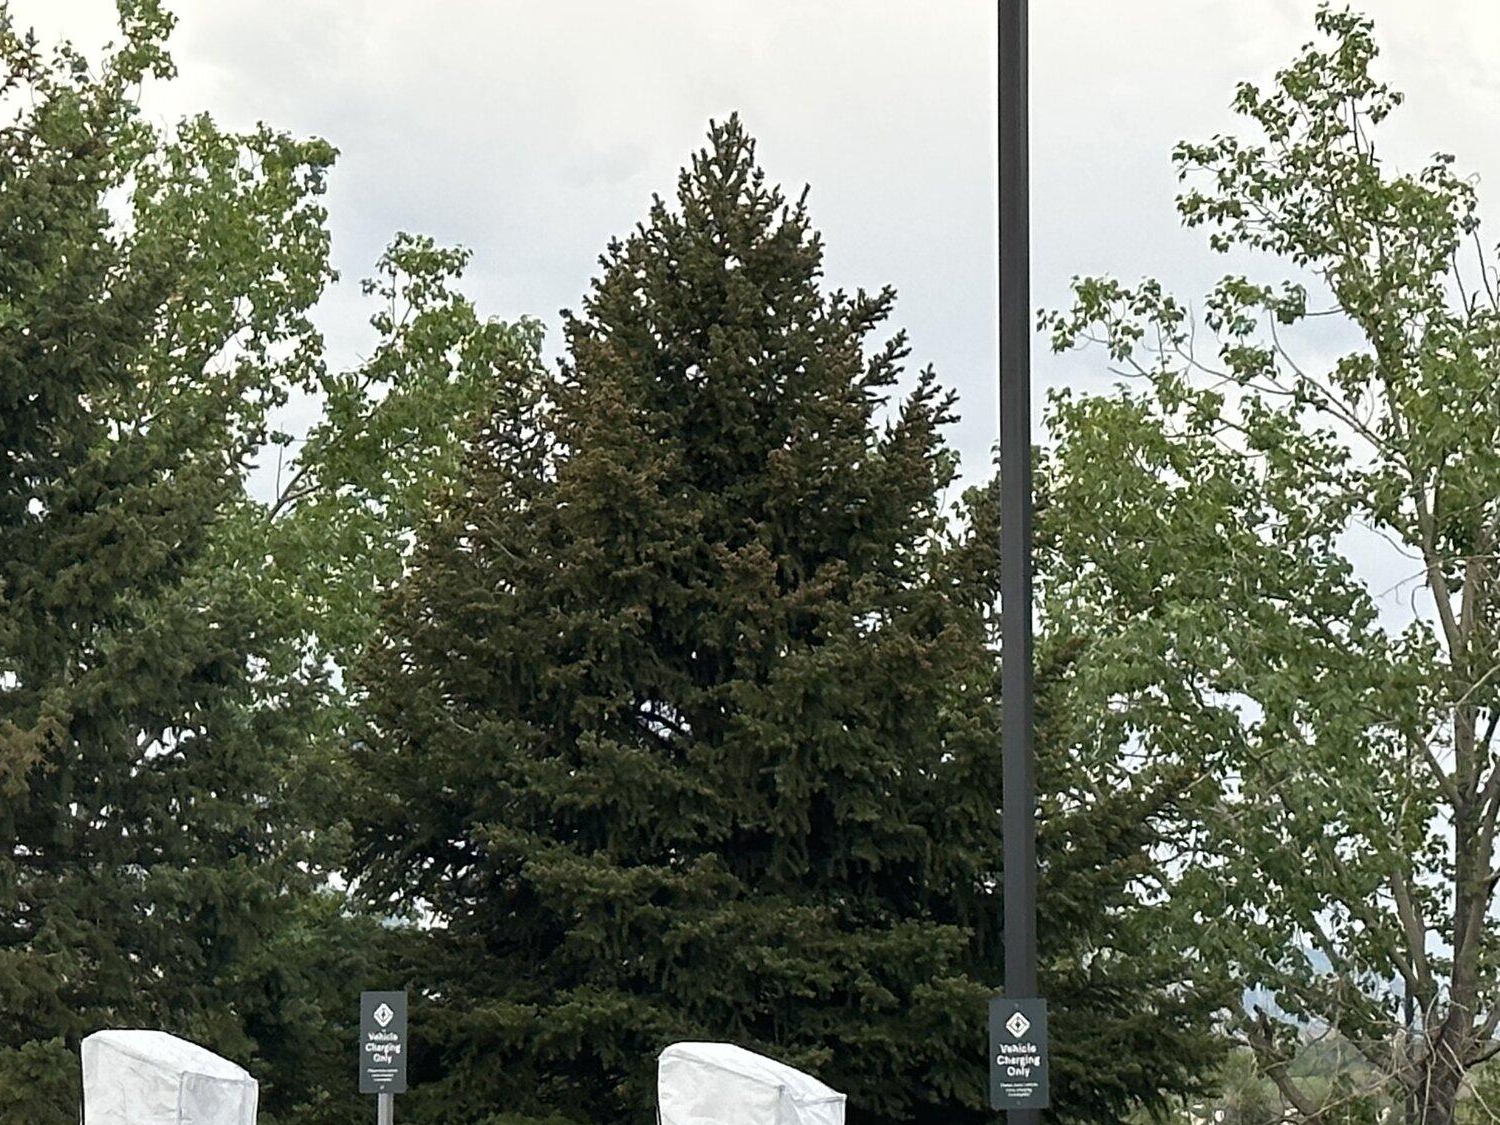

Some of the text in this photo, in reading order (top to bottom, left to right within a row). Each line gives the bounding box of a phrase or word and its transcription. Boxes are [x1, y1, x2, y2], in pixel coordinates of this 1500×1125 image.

[367, 1031, 399, 1041] Vehicle
[365, 1042, 401, 1054] Charging
[999, 1042, 1037, 1054] Vehicle
[372, 1052, 392, 1064] Only
[996, 1054, 1041, 1067] Charging
[1006, 1065, 1030, 1078] Only
